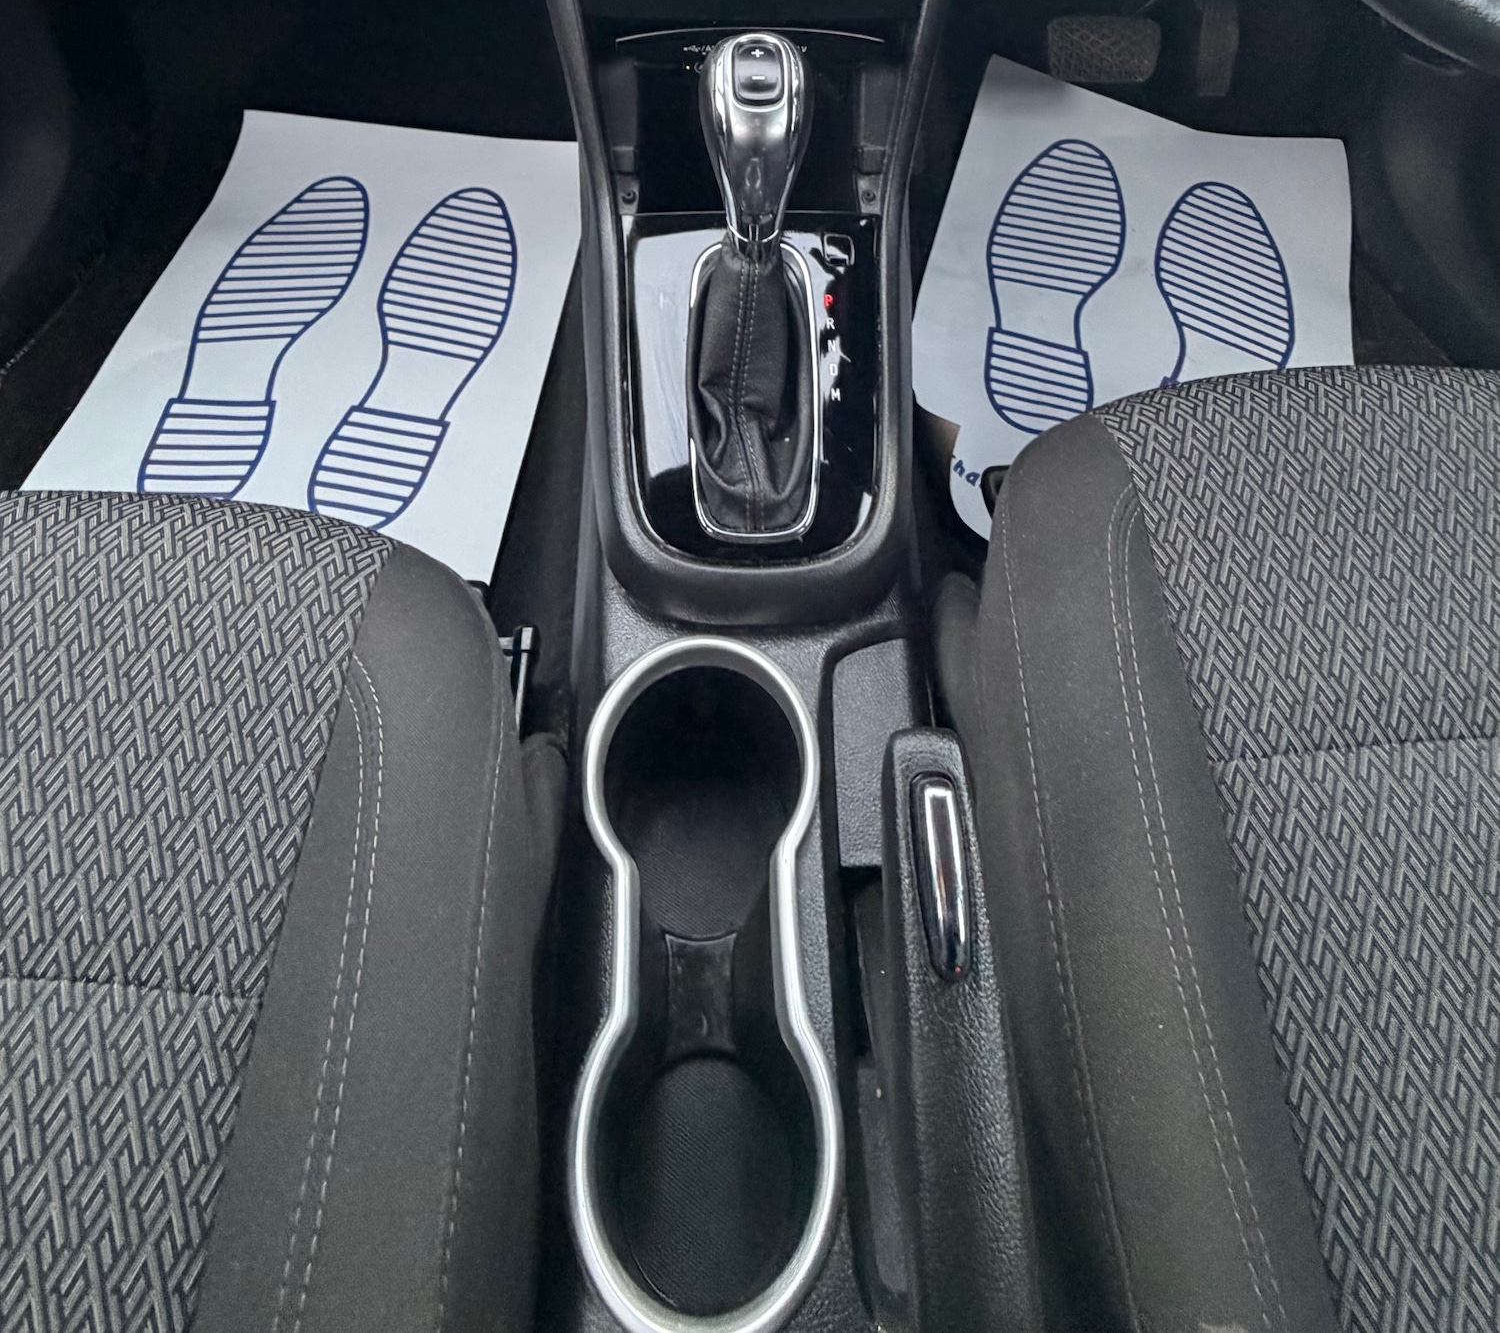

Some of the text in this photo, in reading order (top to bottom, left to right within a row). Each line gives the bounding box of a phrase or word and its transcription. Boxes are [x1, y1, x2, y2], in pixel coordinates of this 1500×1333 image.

[823, 294, 834, 308] P
[826, 318, 836, 330] R
[827, 339, 836, 352] N
[829, 364, 838, 376] D
[831, 388, 841, 402] M
